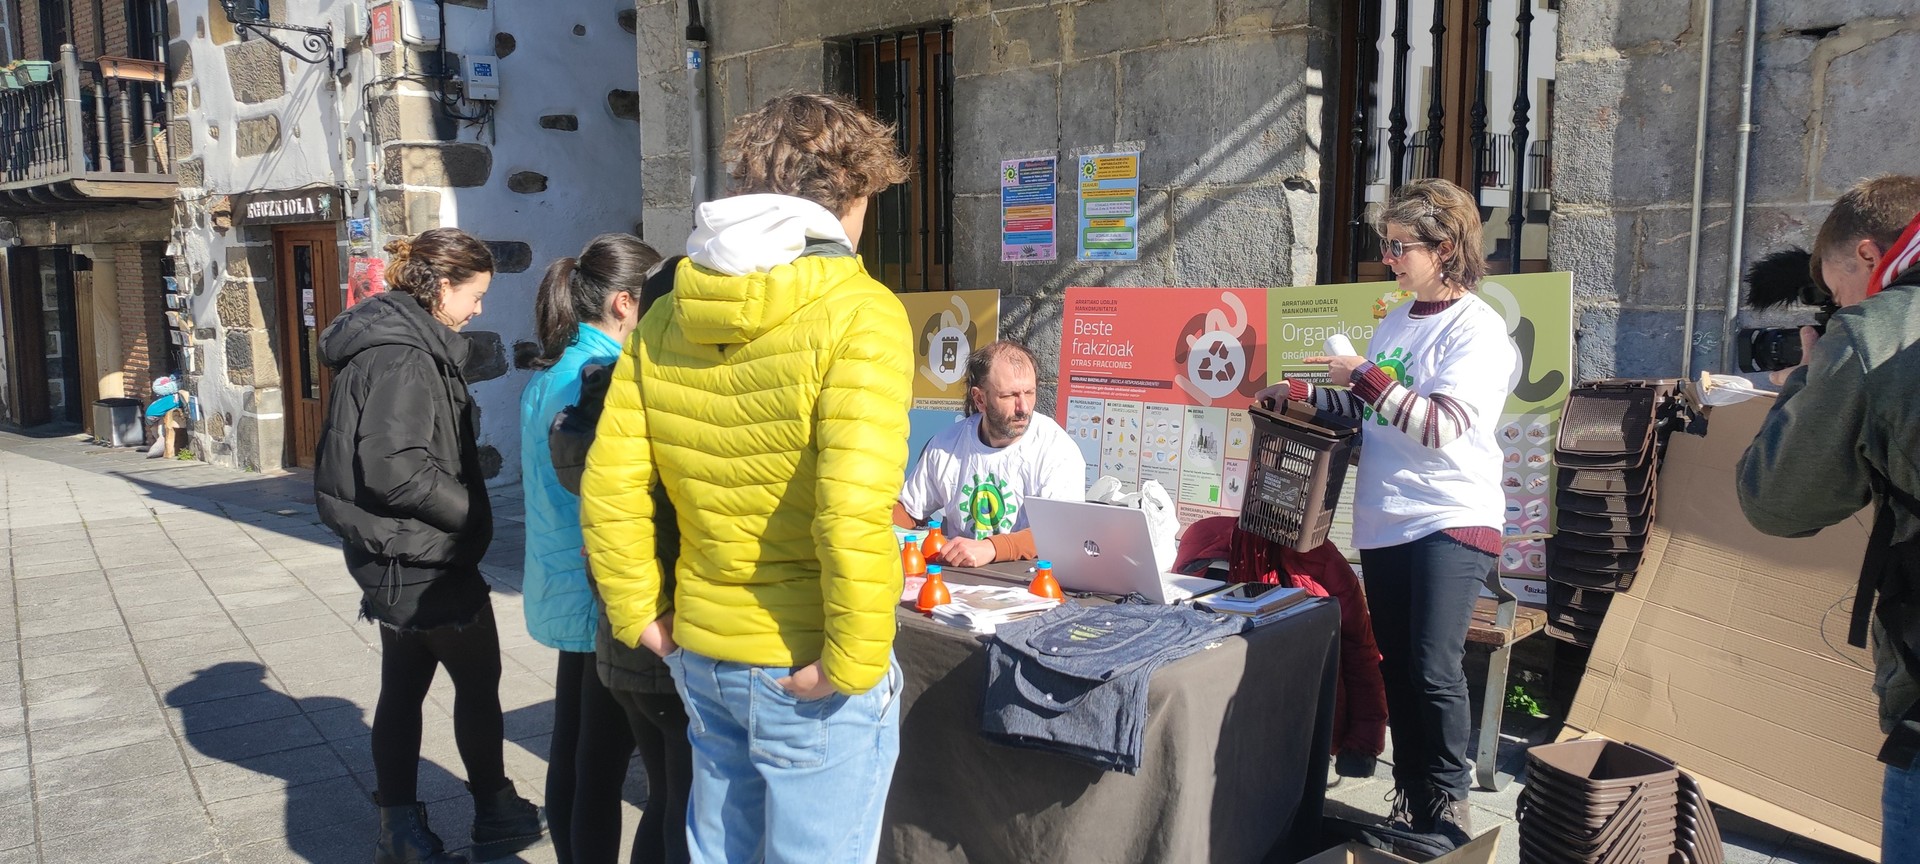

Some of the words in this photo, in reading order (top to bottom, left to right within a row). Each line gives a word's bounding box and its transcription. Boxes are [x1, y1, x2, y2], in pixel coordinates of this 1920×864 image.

[246, 197, 315, 219] EGUZKIOLA
[1281, 299, 1314, 307] ARRATIAKO
[1314, 298, 1338, 306] UDALEN
[1281, 306, 1338, 315] MANKOMUNITATEA
[1074, 318, 1113, 336] Beste
[1282, 321, 1374, 347] Organikoa
[1072, 337, 1135, 357] frakzioak
[1070, 358, 1092, 367] OTRAS
[1092, 359, 1133, 369] FRACCIONES
[1084, 539, 1101, 558] hp
